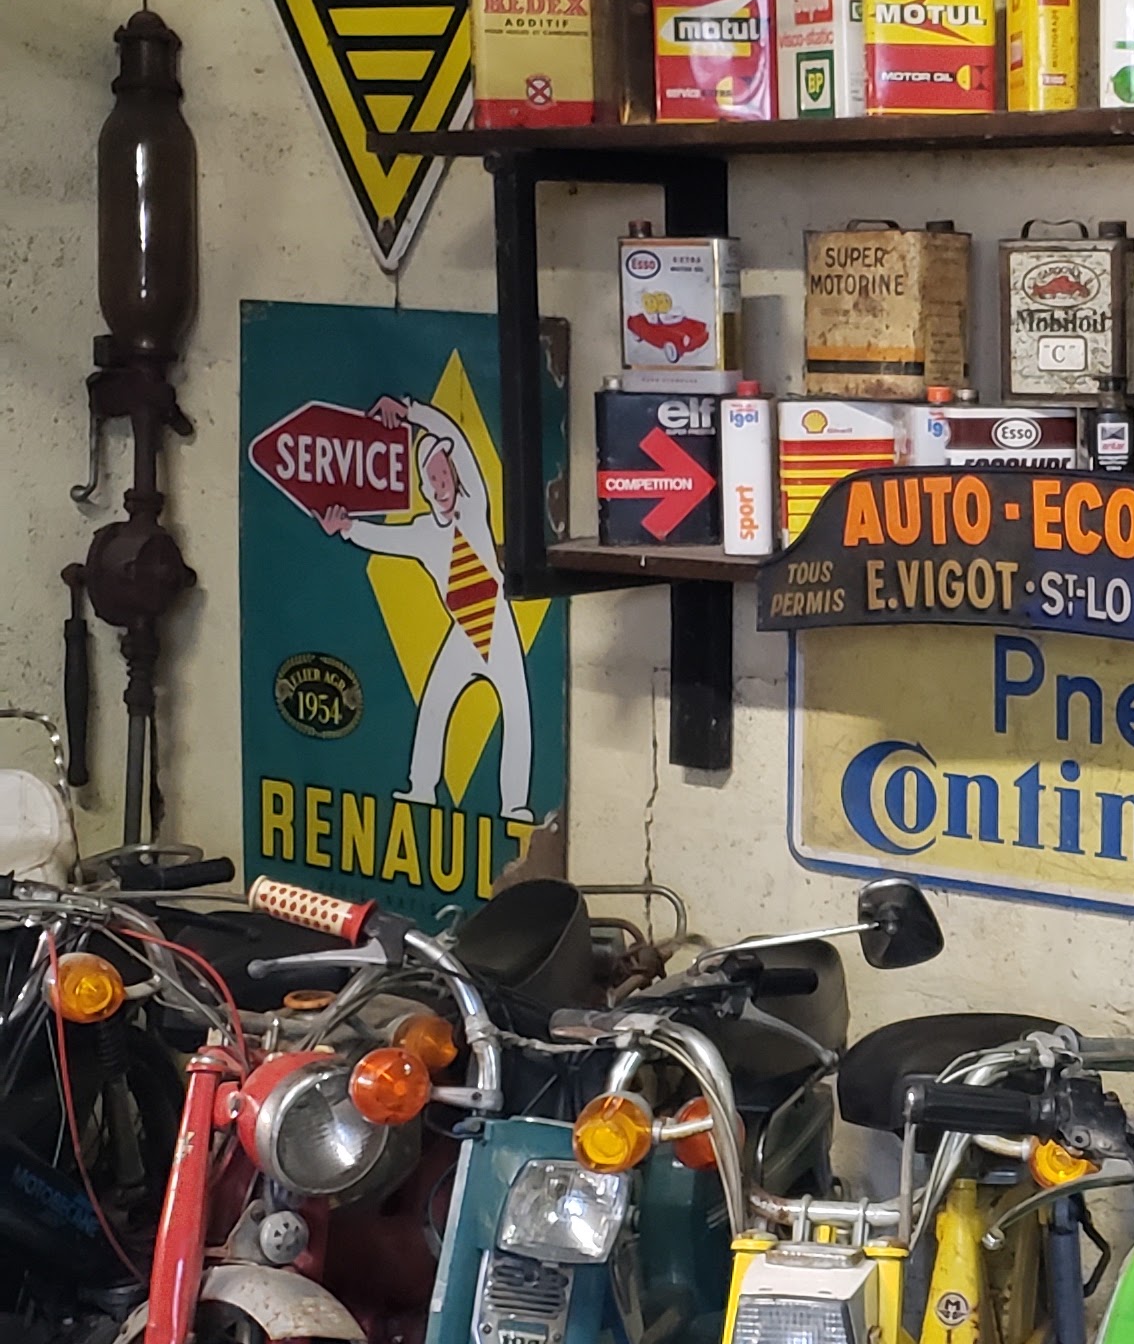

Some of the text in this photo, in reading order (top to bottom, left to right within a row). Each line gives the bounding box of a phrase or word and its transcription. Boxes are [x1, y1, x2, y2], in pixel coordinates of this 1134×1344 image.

[505, 18, 569, 28] ADDITIF
[875, 4, 988, 27] MOTUL
[678, 18, 760, 41] motul
[808, 72, 823, 92] BP
[882, 70, 954, 83] MOTOR OIL
[825, 247, 887, 271] SUPER
[809, 273, 905, 298] MOTORINE
[657, 397, 716, 429] elf
[730, 410, 758, 428] igol
[928, 420, 943, 438] ig
[1001, 426, 1033, 440] Esso
[275, 431, 405, 493] SERVICE
[605, 477, 693, 491] COMPETITION
[736, 485, 759, 541] sport
[787, 561, 833, 585] TOUS
[769, 588, 845, 618] PERMIS
[297, 690, 343, 726] 1954
